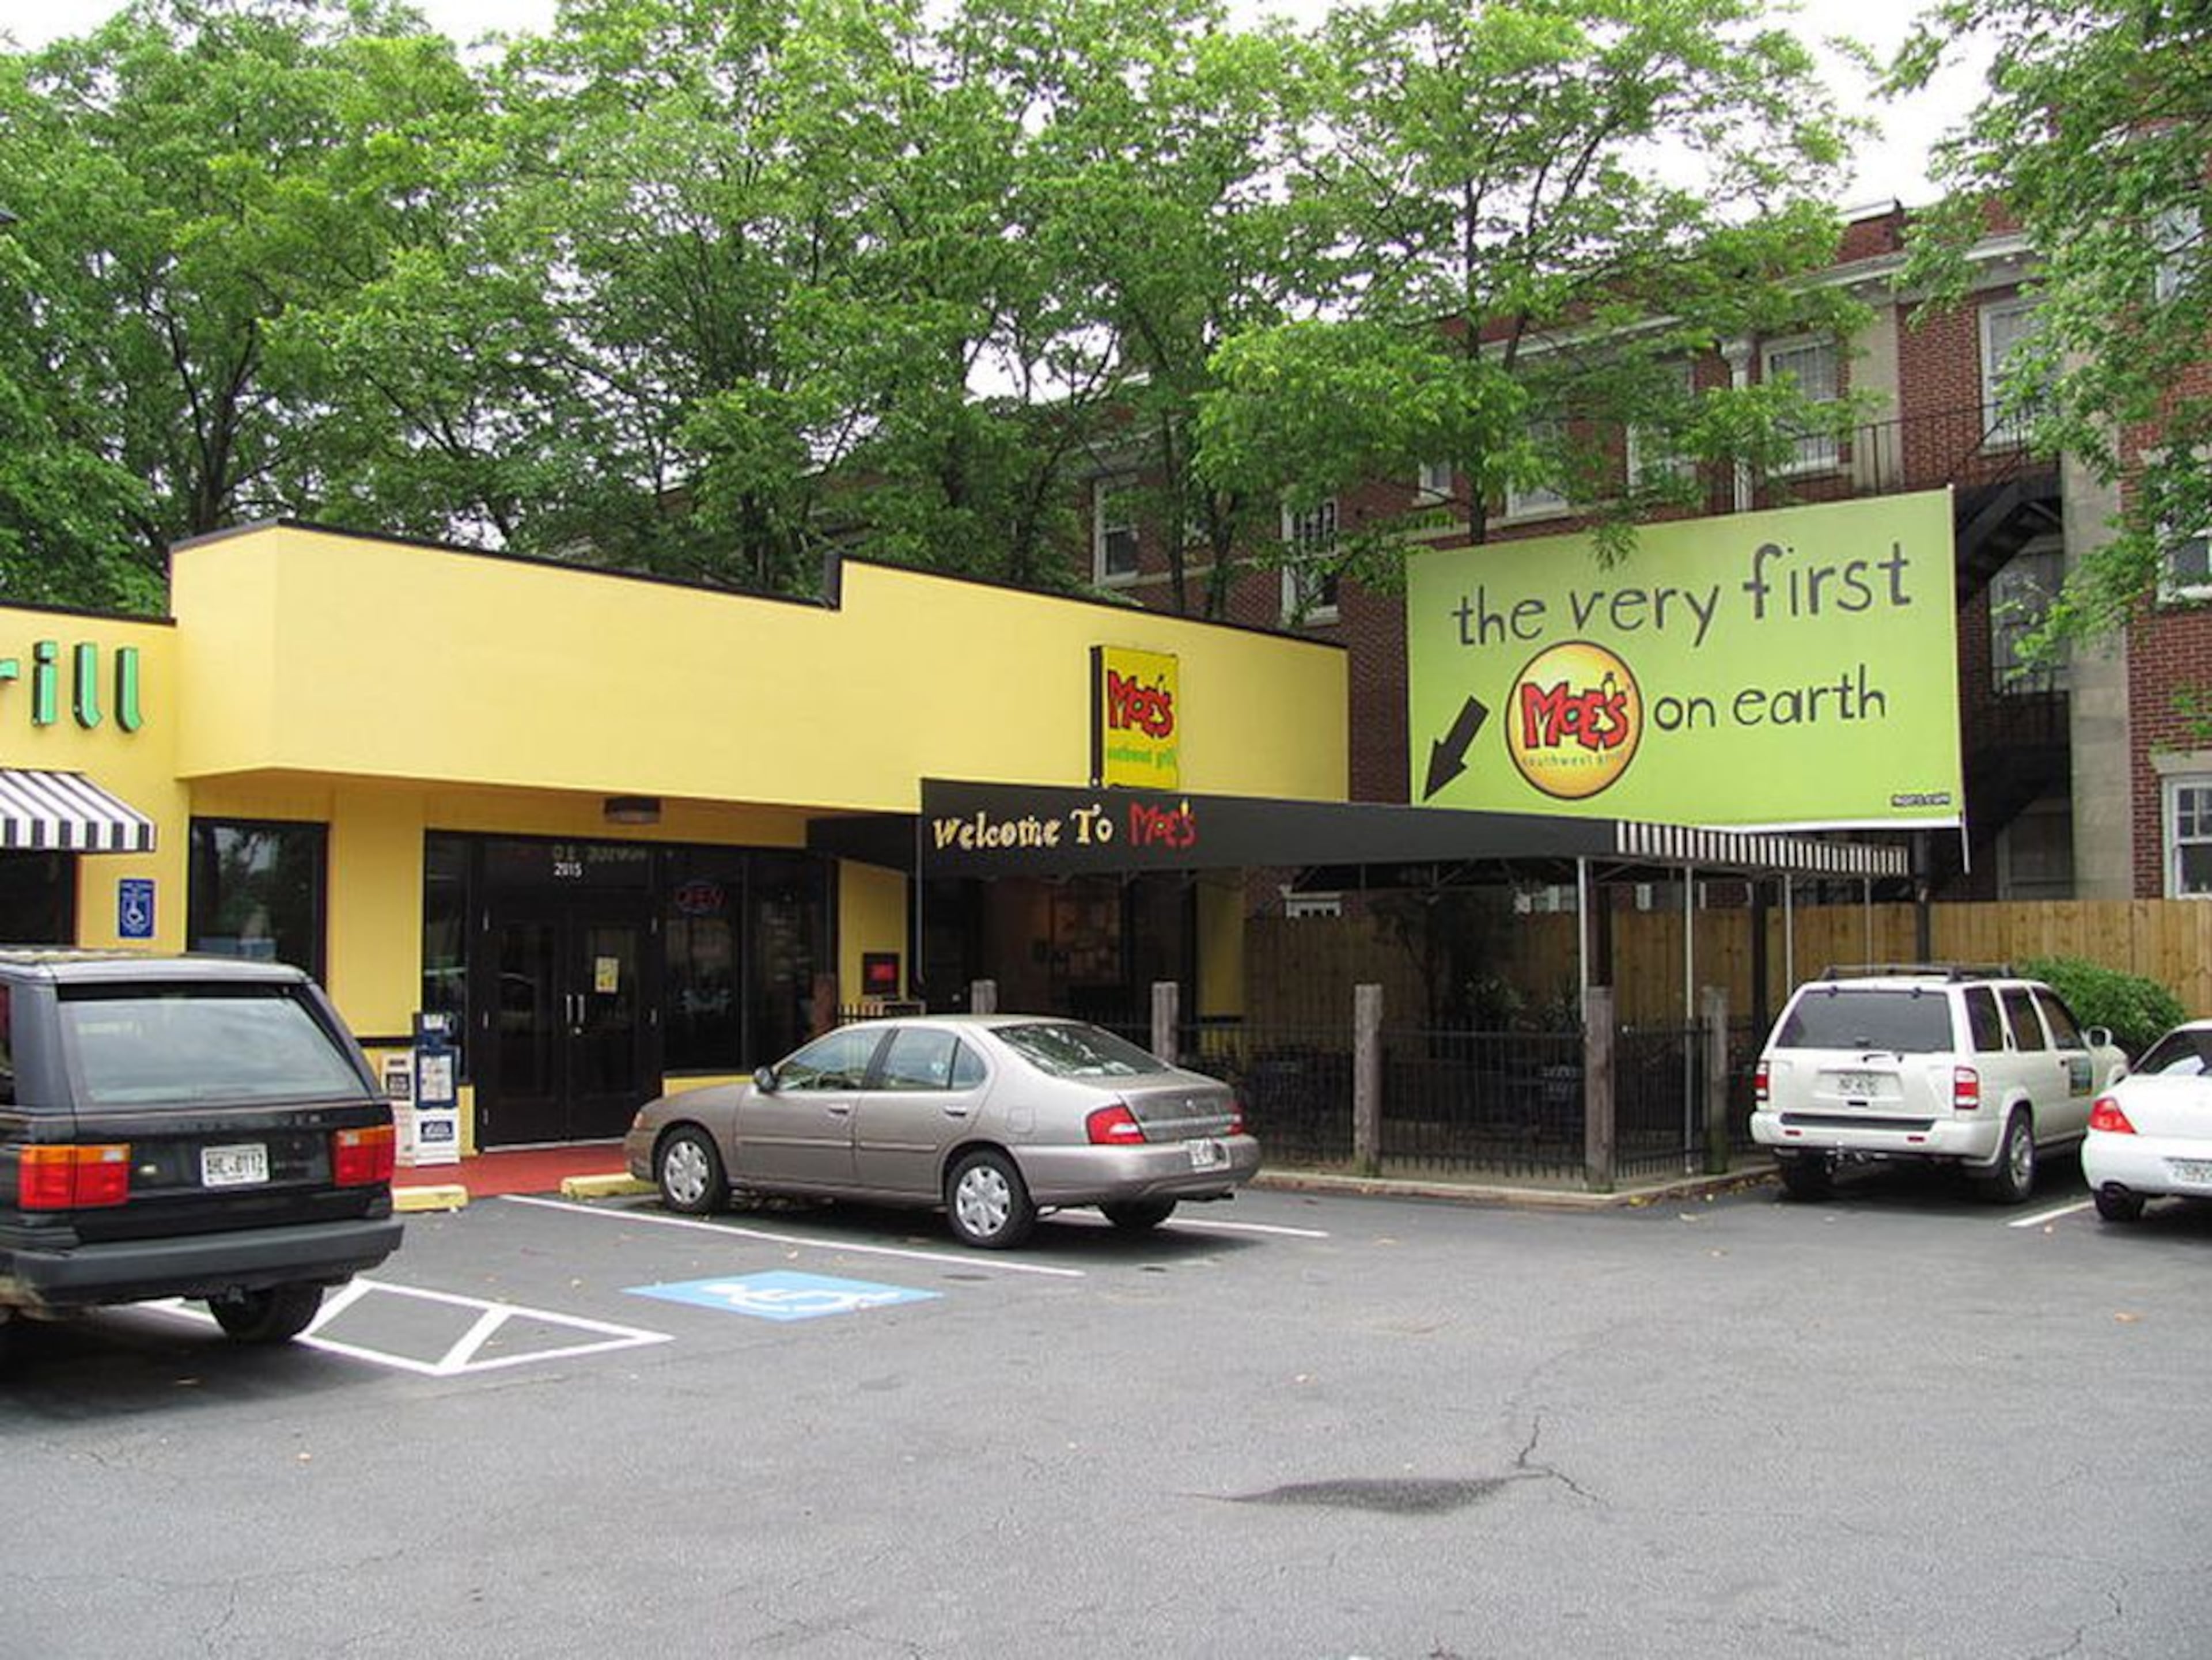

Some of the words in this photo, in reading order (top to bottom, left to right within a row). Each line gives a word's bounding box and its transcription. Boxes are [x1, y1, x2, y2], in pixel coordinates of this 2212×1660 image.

[1451, 583, 1546, 646] the
[1569, 583, 1719, 647] very
[1743, 541, 1911, 620] first
[1654, 696, 1715, 731] on
[1732, 662, 1886, 726] earth
[933, 811, 1062, 850] Welcome
[1070, 804, 1114, 844] To
